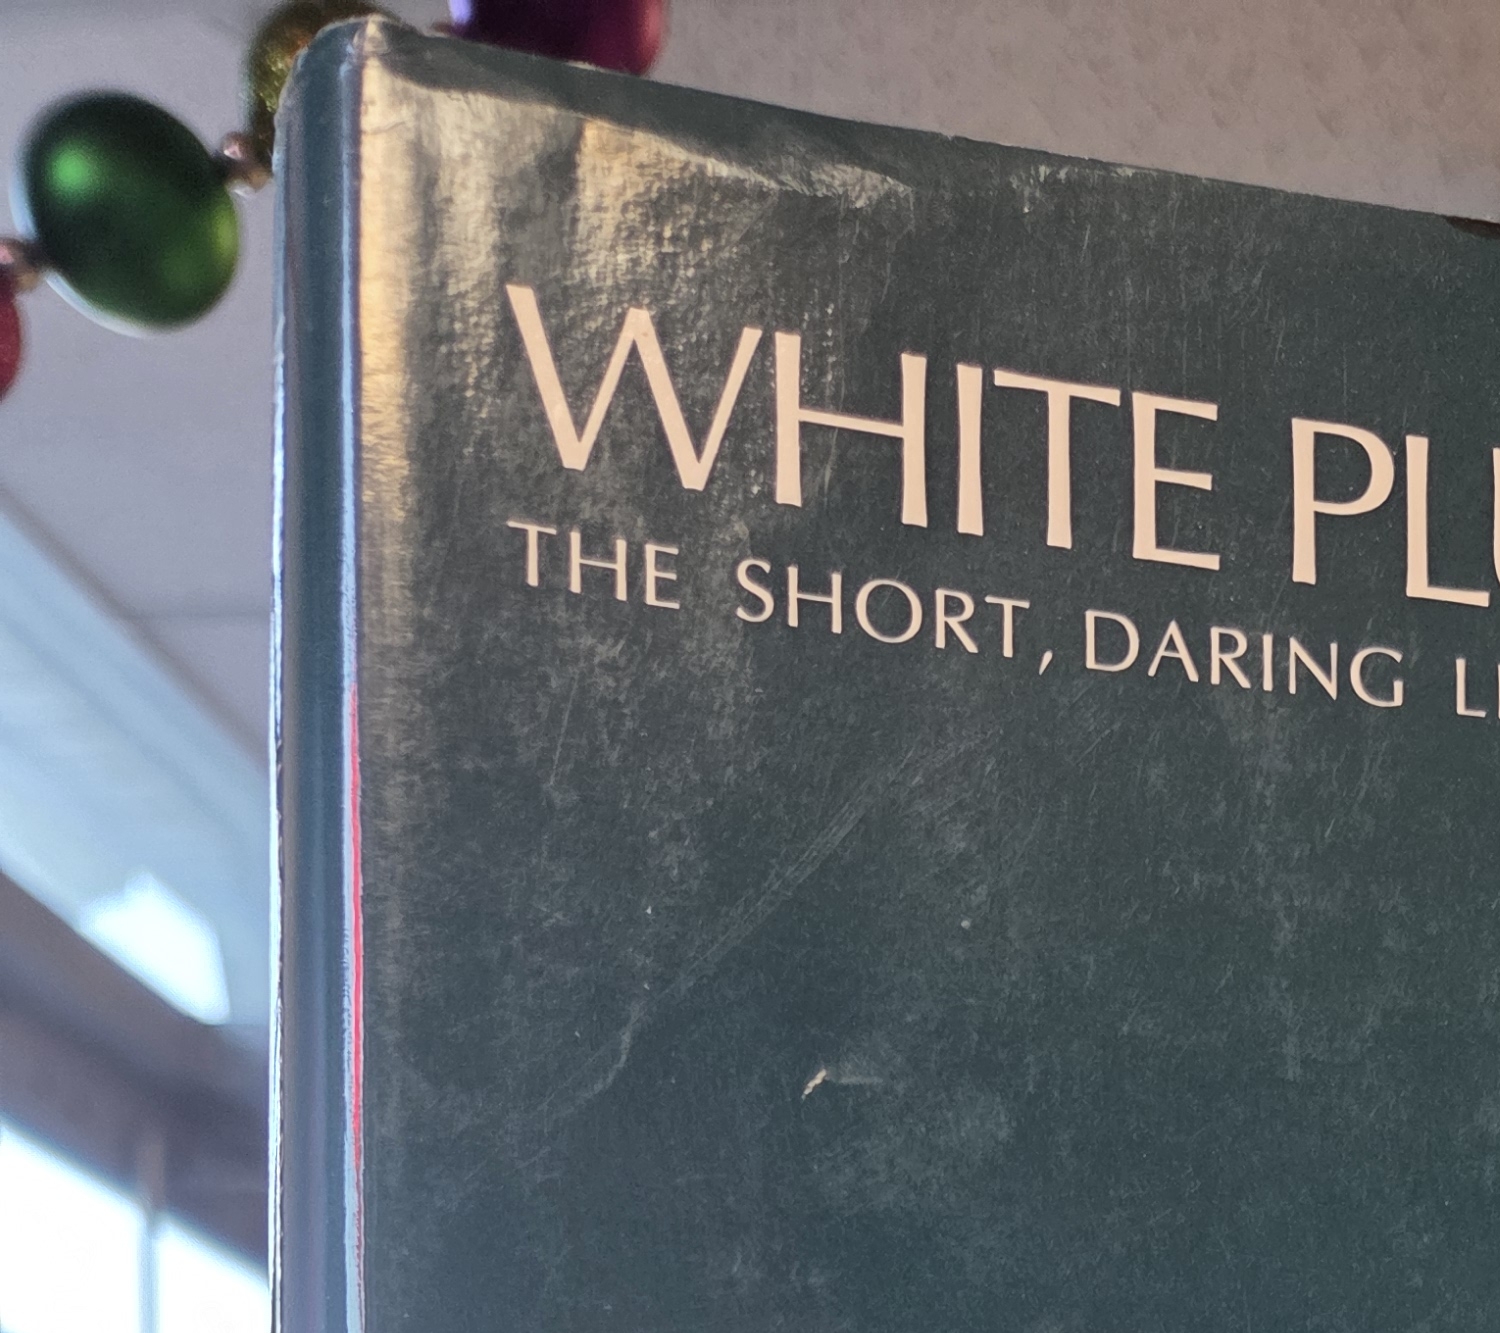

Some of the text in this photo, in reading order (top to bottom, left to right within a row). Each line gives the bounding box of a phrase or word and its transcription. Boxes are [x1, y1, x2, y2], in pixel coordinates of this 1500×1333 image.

[503, 282, 1222, 572] WHITE
[504, 518, 681, 611] THE
[734, 556, 1054, 676] SHORT,
[1084, 608, 1405, 709] DARING
